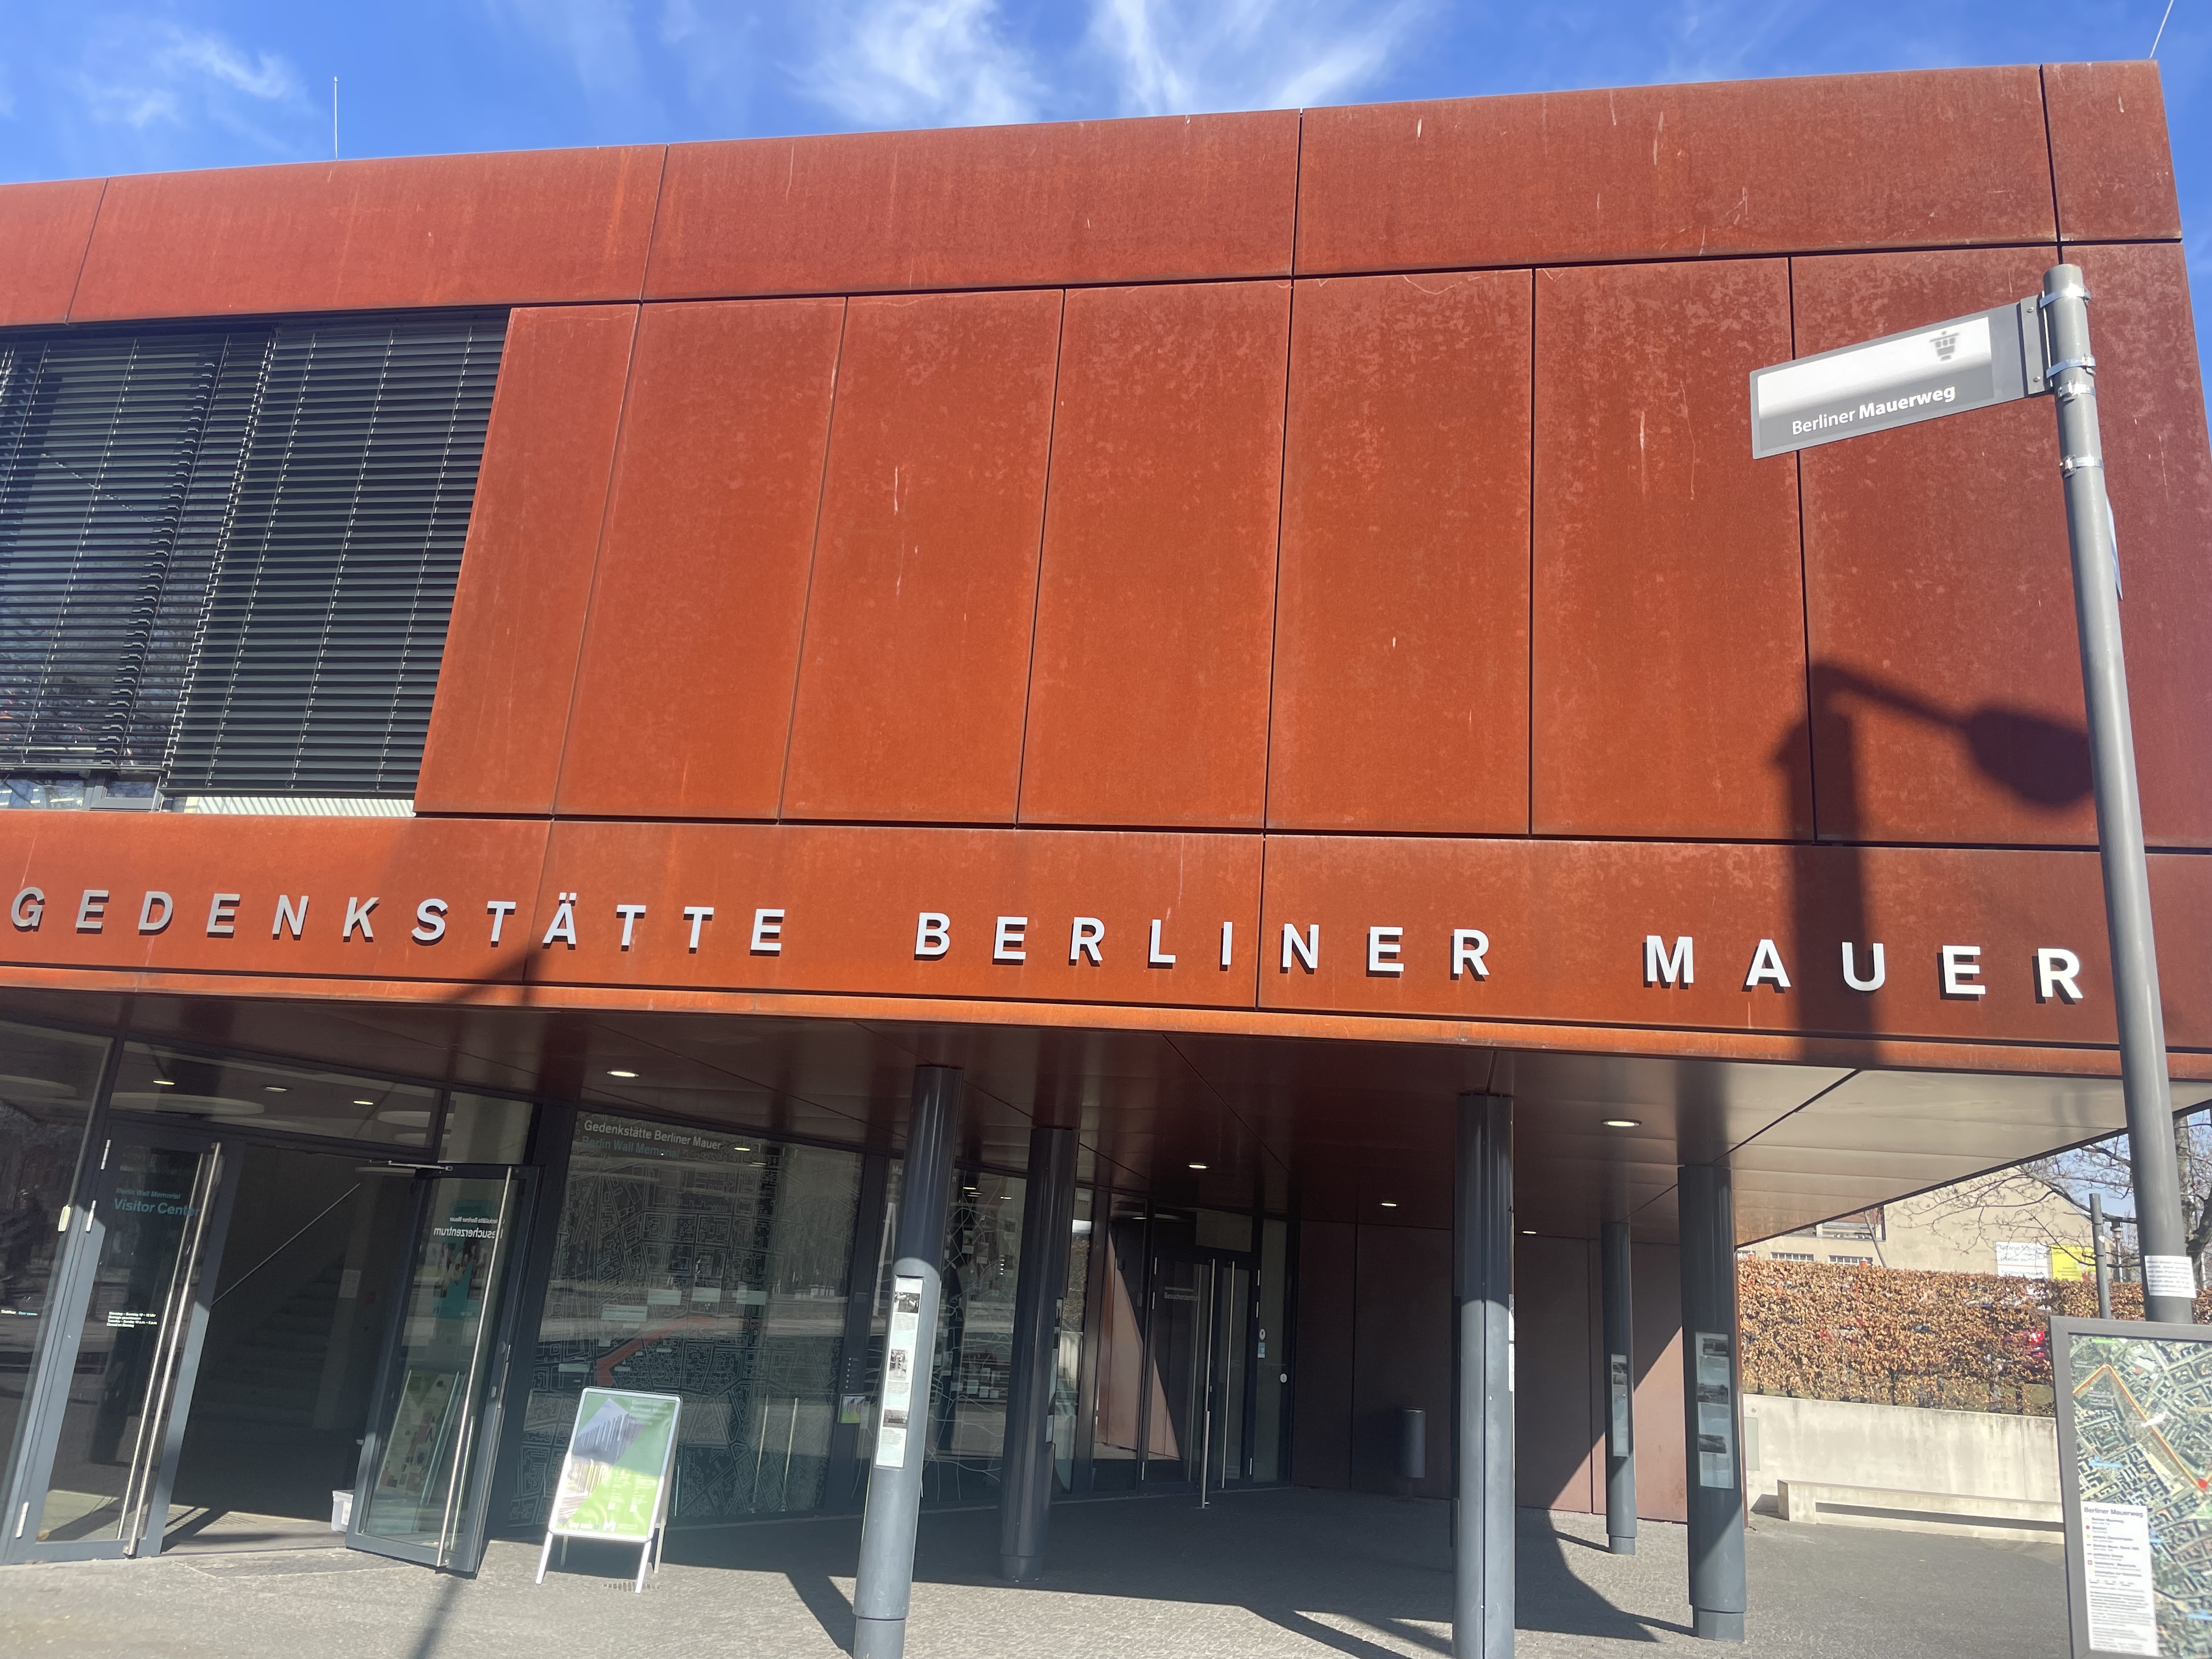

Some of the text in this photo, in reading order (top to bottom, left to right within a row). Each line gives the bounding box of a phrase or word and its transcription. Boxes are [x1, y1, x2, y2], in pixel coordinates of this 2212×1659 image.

[1792, 386, 1956, 435] Berliner Mauerweg
[10, 887, 2084, 999] GEDENKSTÄTTE BERLINER MAUER
[582, 1136, 680, 1159] Berlin Wall Memorial
[584, 1120, 721, 1150] Gedenkstätte Berliner Mauer
[114, 1198, 200, 1217] Visitor Center
[2111, 1509, 2143, 1518] Mauerweg
